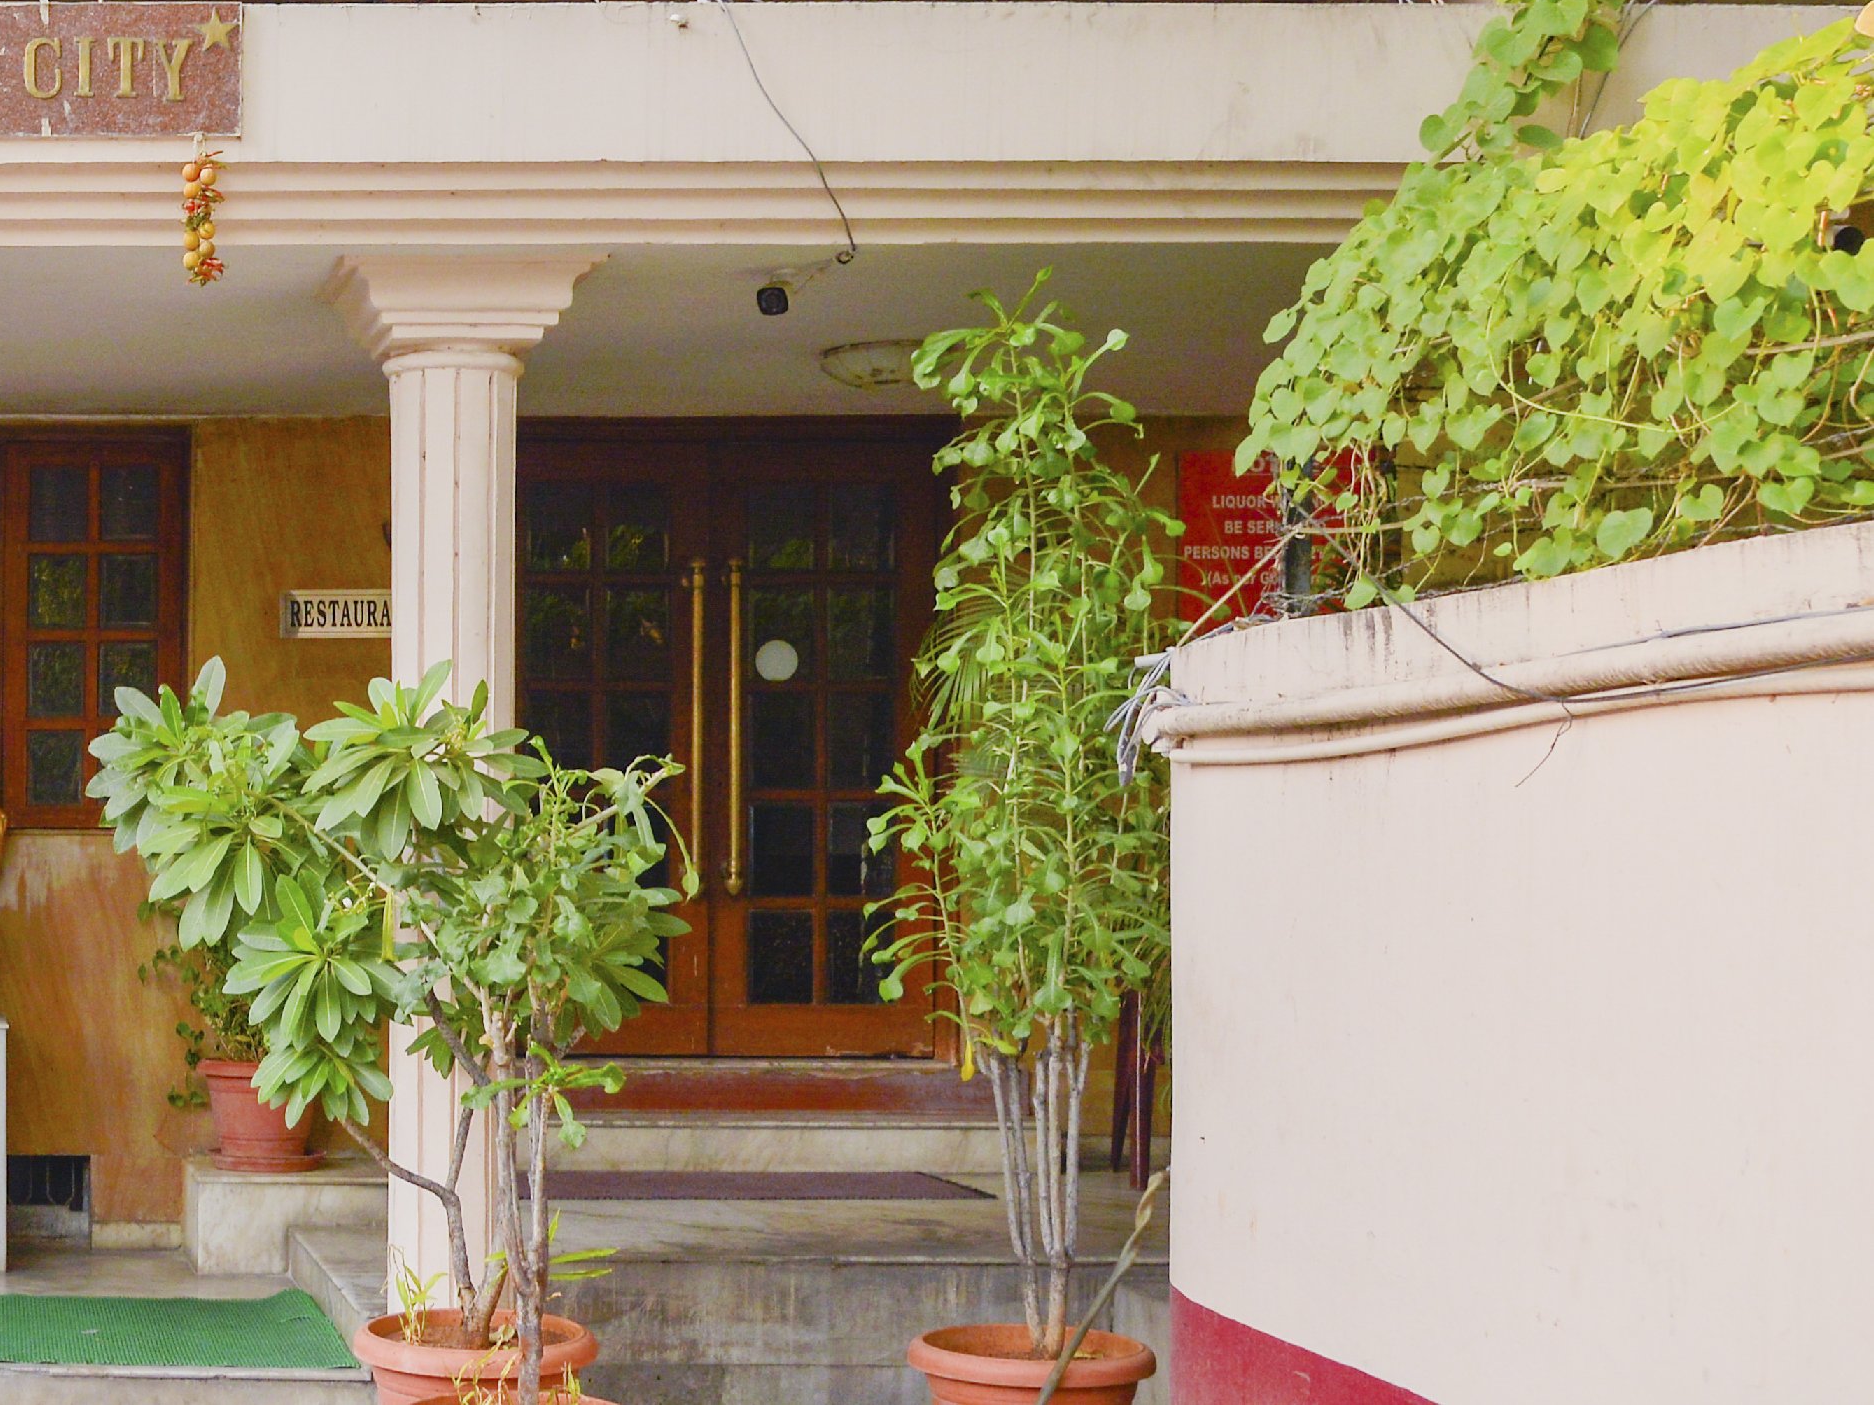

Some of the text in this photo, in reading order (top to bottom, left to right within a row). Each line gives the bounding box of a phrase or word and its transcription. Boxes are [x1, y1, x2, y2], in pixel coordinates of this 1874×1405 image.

[23, 35, 194, 102] CITY
[1212, 495, 1266, 509] LIQUOR
[1224, 520, 1243, 534] BE
[1184, 546, 1250, 560] PERSONS
[289, 600, 392, 627] RESTAURA
